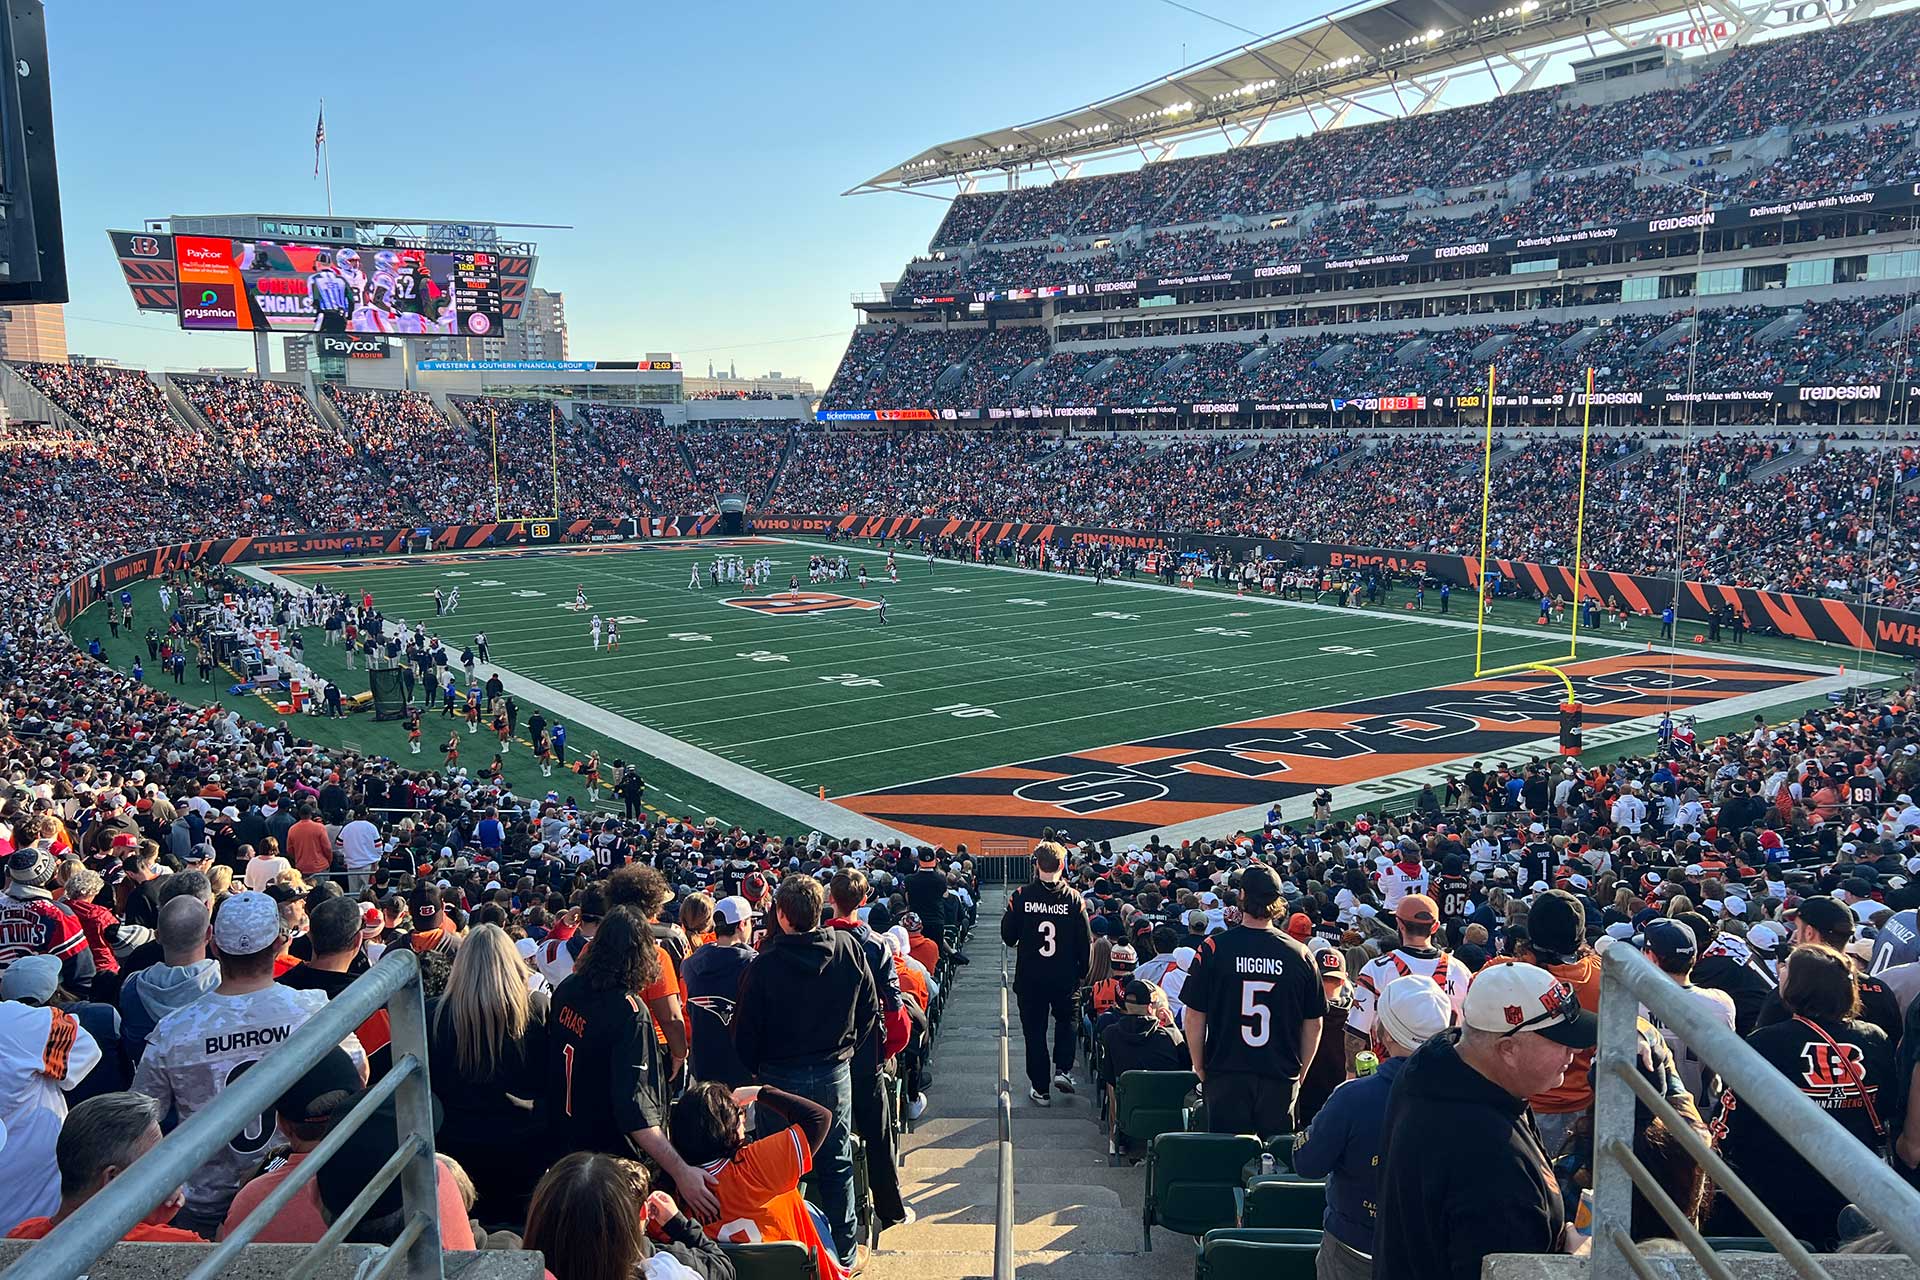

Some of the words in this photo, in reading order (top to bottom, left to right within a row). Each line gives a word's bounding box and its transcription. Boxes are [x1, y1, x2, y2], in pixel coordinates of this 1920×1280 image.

[1750, 204, 1791, 217] Delivering
[1792, 200, 1816, 211] Value
[1816, 197, 1837, 208] with
[1838, 191, 1875, 206] Velocity
[1517, 235, 1552, 248] Delivering
[1552, 232, 1571, 243] Value
[1572, 229, 1588, 240] with
[1588, 227, 1618, 240] Velocity
[187, 248, 222, 259] Paycor
[1325, 258, 1354, 270] Delivering
[1355, 257, 1371, 266] Value
[1371, 255, 1385, 265] with
[1385, 253, 1410, 264] Velocity
[914, 296, 934, 305] Paycor
[184, 307, 236, 318] prysmian
[324, 337, 383, 354] Paycor
[1365, 399, 1378, 409] 20
[1383, 398, 1395, 409] 13
[1433, 398, 1443, 407] 40
[1456, 396, 1479, 406] 12:03
[1491, 396, 1506, 405] 1ST
[1518, 395, 1529, 405] 10
[1552, 395, 1564, 404] 33
[1666, 391, 1701, 402] Delivering
[1702, 390, 1724, 401] Value
[1724, 390, 1741, 400] with
[1742, 389, 1774, 401] Velocity
[826, 411, 871, 419] ticketmaster
[1255, 403, 1281, 411] Delivering
[1308, 402, 1328, 410] Velocity
[534, 526, 547, 536] 36
[752, 519, 790, 530] WHO
[803, 520, 832, 531] DEY
[253, 541, 292, 555] THE
[301, 536, 385, 551] JUNGLE
[1073, 532, 1164, 549] CINCINNATI
[114, 566, 129, 581] WHO
[132, 558, 148, 575] DEY
[1330, 552, 1427, 572] BENGALS
[1878, 620, 1920, 646] WH
[818, 673, 880, 687] 20
[931, 703, 995, 718] 10
[1012, 668, 1718, 814] BENGALS
[1355, 777, 1424, 796] US
[1855, 788, 1872, 802] 89
[1631, 808, 1636, 823] 1
[570, 855, 579, 865] 10
[596, 847, 612, 866] 10
[1491, 849, 1497, 860] 5
[1541, 859, 1547, 880] 1
[735, 881, 741, 896] 1
[1404, 885, 1422, 896] 11
[1024, 901, 1047, 913] EMMA
[1048, 903, 1069, 915] ROSE
[1444, 893, 1466, 915] 85
[0, 921, 46, 946] TRIOTS
[1038, 921, 1057, 957] 3
[1316, 930, 1341, 941] BIRDMAN
[1885, 918, 1916, 945] GONZALEZ
[1235, 956, 1283, 976] HIGGINS
[559, 1005, 587, 1039] CHASE
[1241, 980, 1276, 1047] 5
[204, 1024, 292, 1056] BURROW
[563, 1043, 574, 1117] 1
